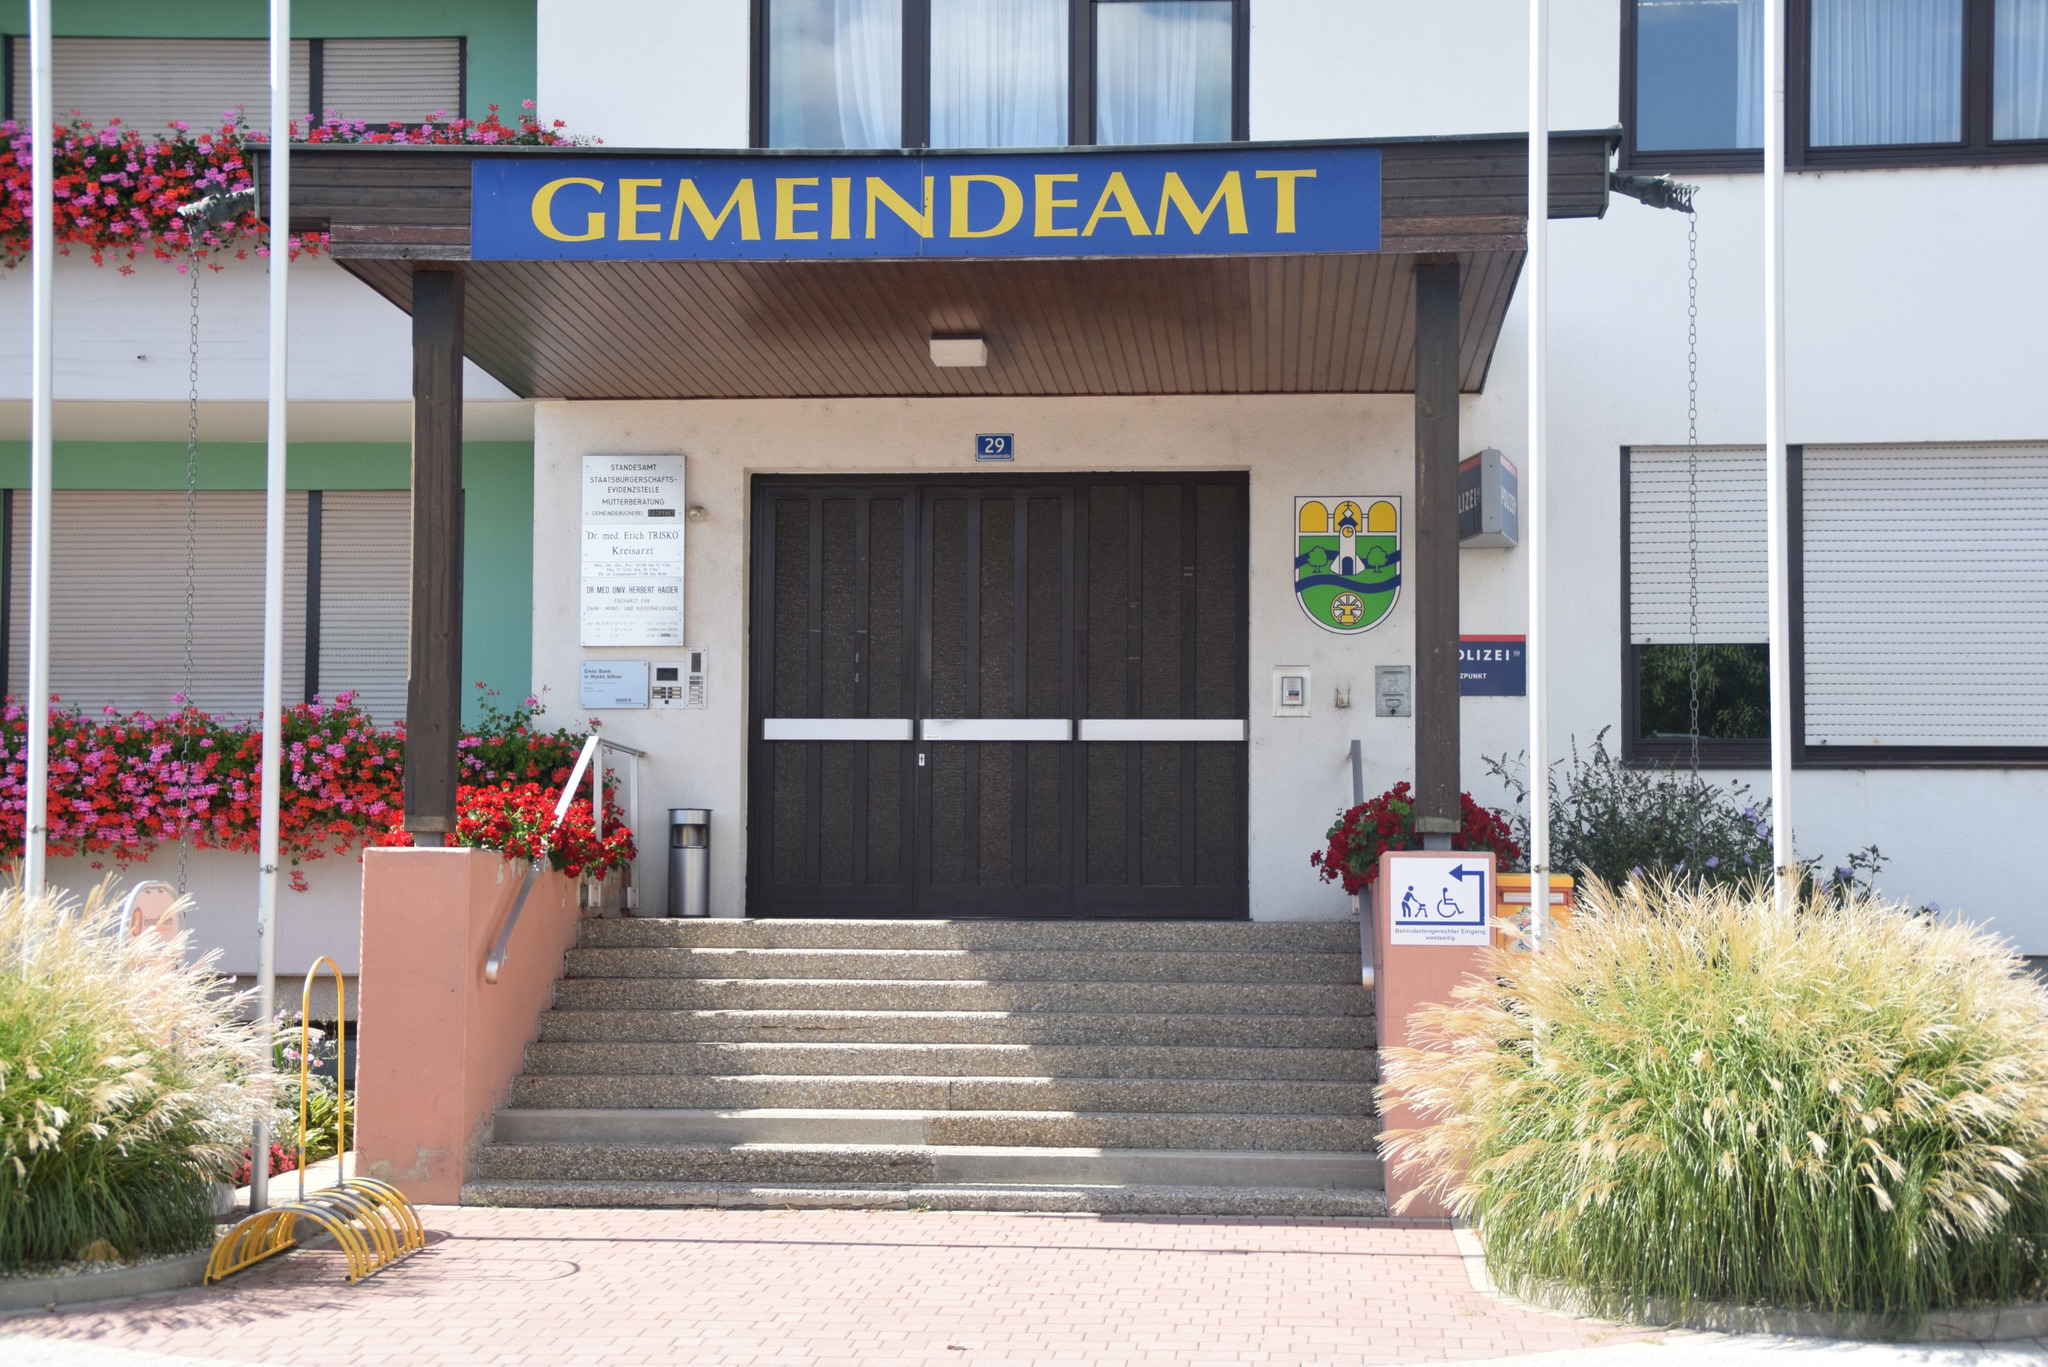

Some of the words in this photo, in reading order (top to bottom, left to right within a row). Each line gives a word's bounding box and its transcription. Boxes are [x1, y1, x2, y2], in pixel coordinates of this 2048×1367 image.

[531, 168, 1317, 243] GEMEINDEAMT
[985, 438, 1004, 453] 29
[1459, 488, 1476, 514] LIZEI
[588, 531, 599, 540] Dr.
[603, 531, 620, 540] med.
[624, 531, 644, 540] Erich
[648, 531, 678, 540] TRISKO
[612, 546, 654, 554] Kreisarzt
[1459, 650, 1510, 661] OLIZEI
